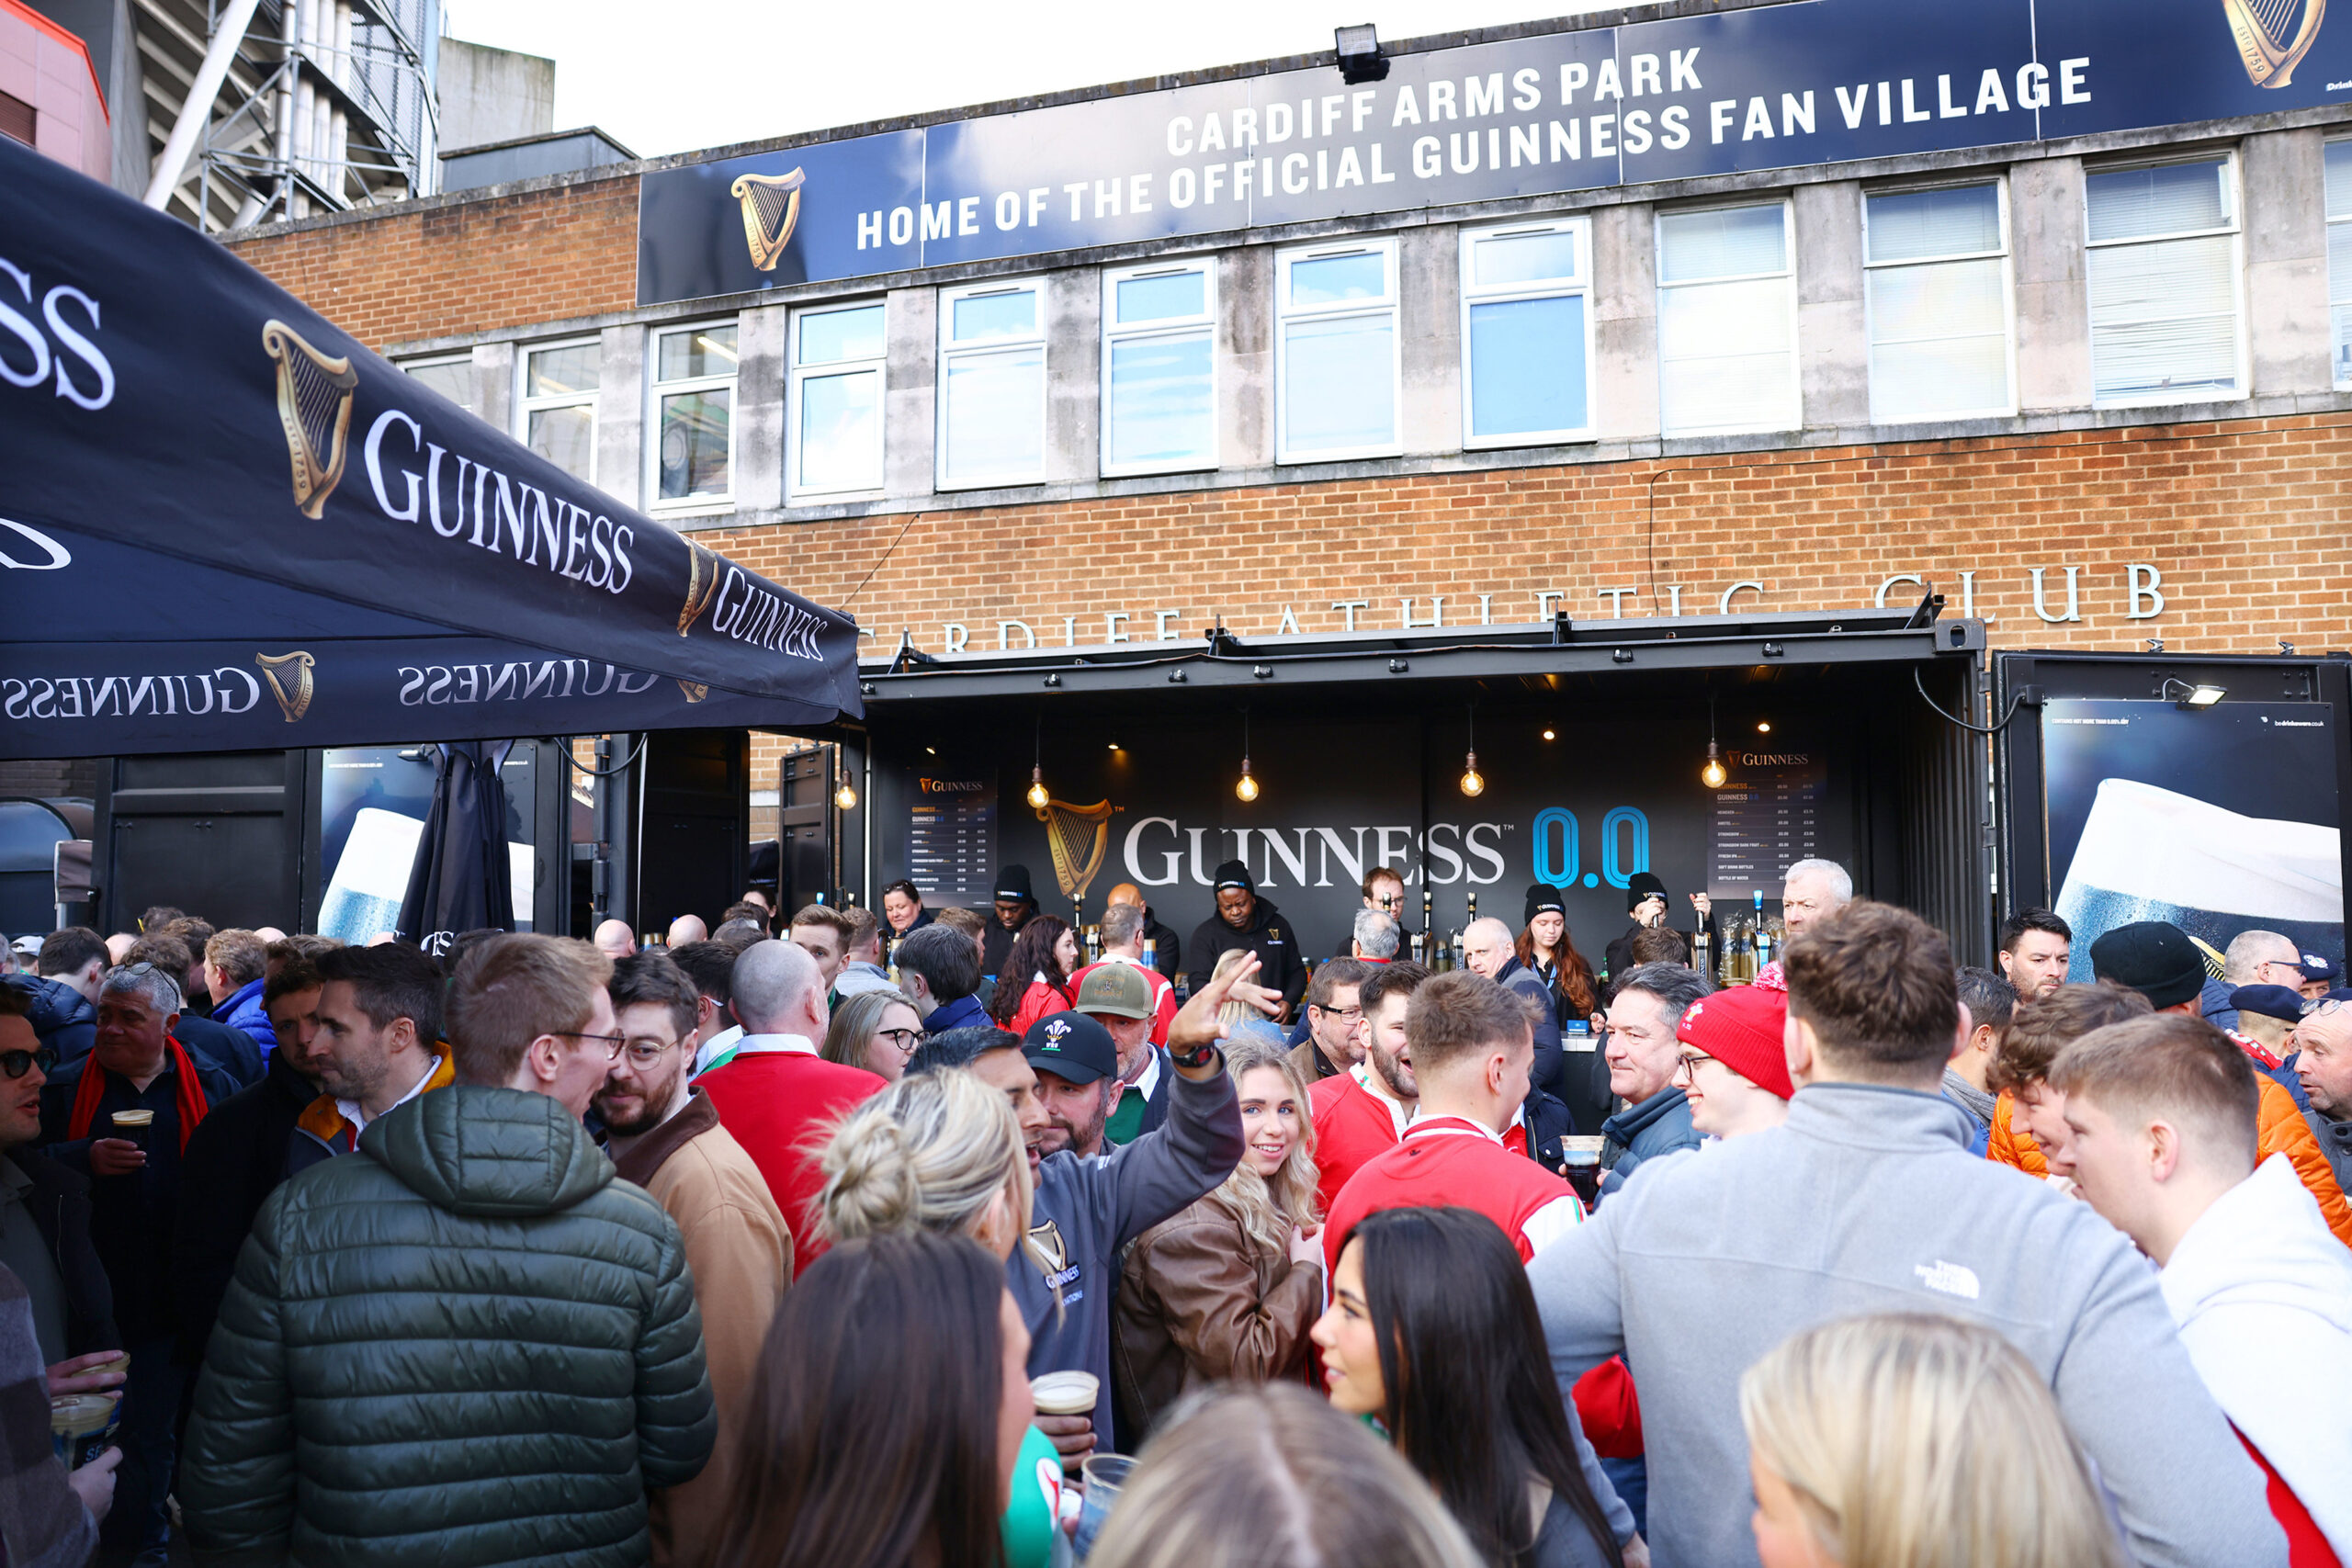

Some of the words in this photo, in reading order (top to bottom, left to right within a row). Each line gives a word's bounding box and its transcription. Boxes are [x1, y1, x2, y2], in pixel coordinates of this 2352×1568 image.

[1167, 89, 1375, 157] CARDIFF
[1392, 67, 1542, 128] ARMS
[1560, 47, 1703, 107] PARK
[856, 195, 980, 251] HOME
[995, 186, 1049, 231] OF
[1063, 173, 1153, 222] THE
[1169, 141, 1395, 209] OFFICIAL
[1412, 105, 1691, 179] GUINNESS
[1710, 90, 1816, 144] FAN
[1834, 56, 2093, 130] VILLAGE
[364, 409, 635, 594] GUINNESS
[712, 566, 828, 661] GUINNESS
[932, 781, 983, 792] GUINNESS
[1742, 753, 1809, 766] GUINNESS
[1124, 817, 1505, 886] GUINNESS
[1532, 806, 1650, 889] 0.0
